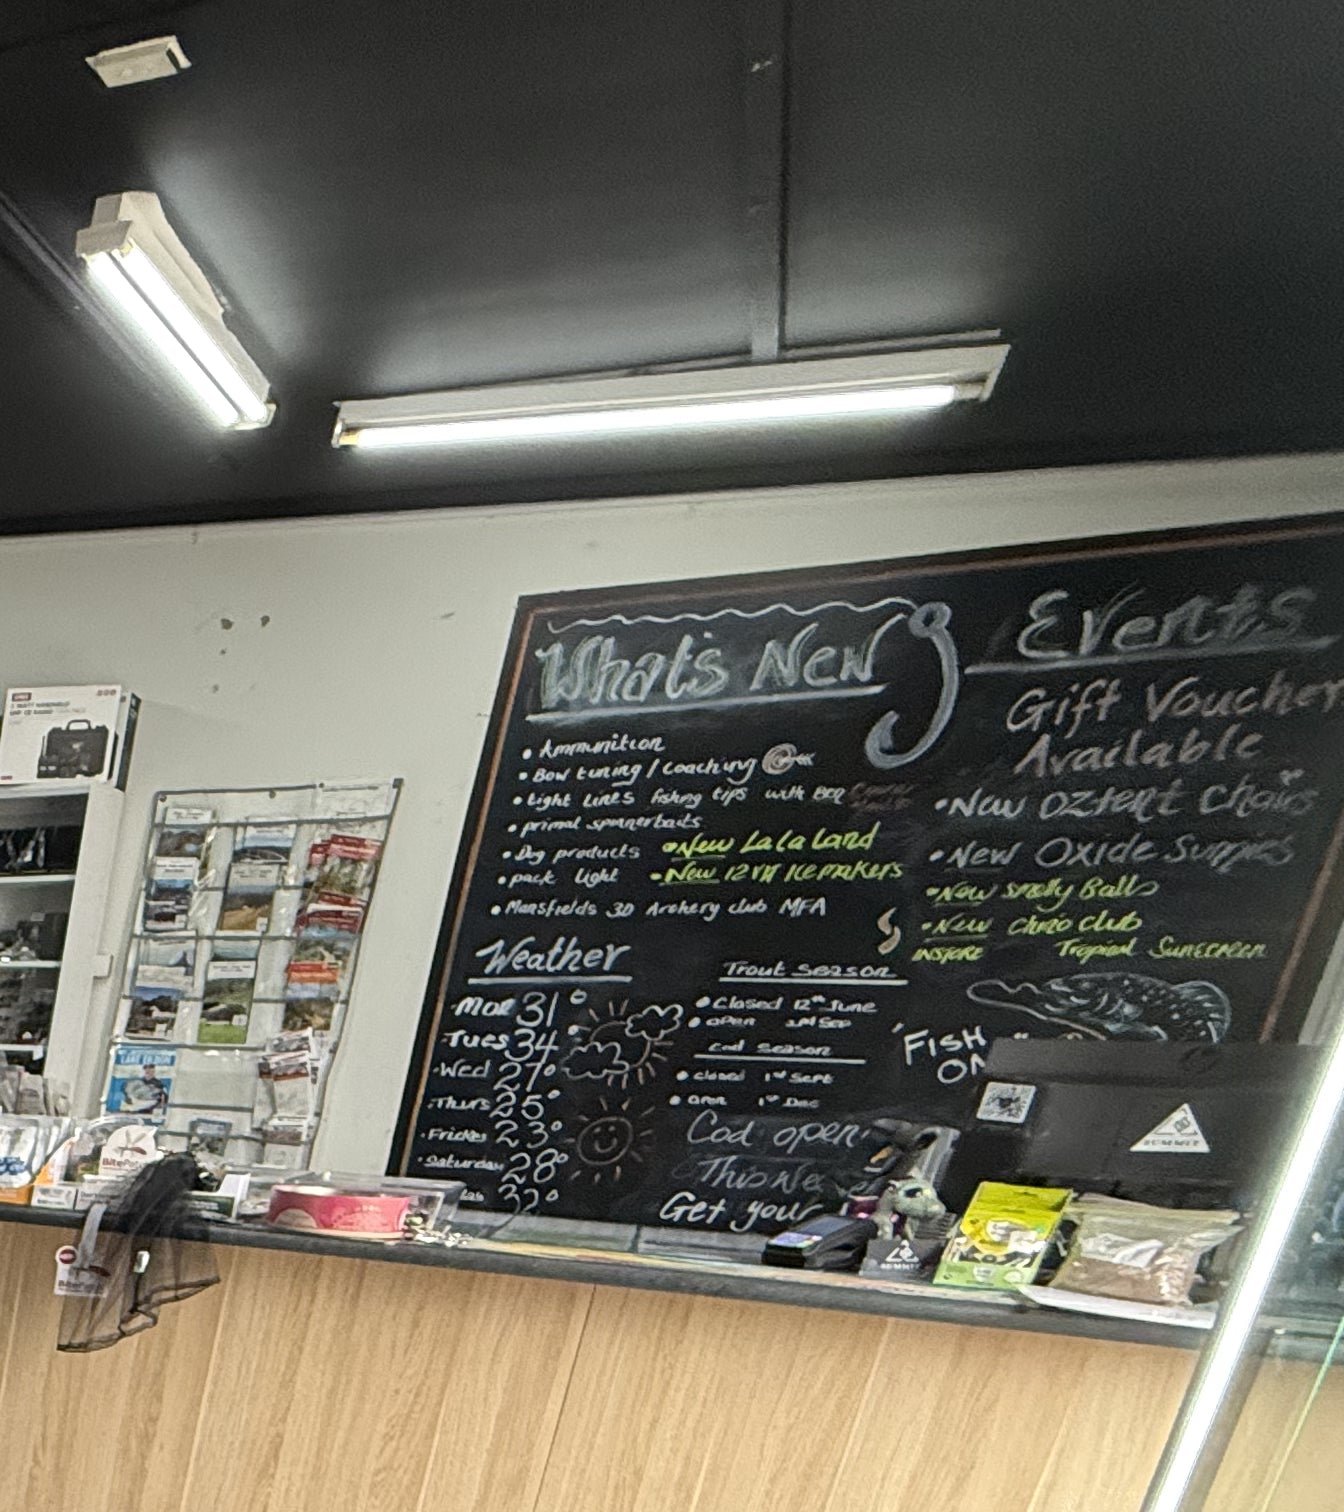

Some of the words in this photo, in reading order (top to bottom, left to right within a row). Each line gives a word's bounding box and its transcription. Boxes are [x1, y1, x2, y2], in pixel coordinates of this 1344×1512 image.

[535, 632, 729, 710] What's
[1007, 677, 1121, 739] Gift
[539, 734, 666, 759] Ammunition
[1014, 722, 1264, 779] Available
[552, 843, 641, 865] products
[1035, 833, 1158, 868] Oxide
[645, 900, 721, 922] Archery
[778, 897, 827, 917] MFA
[475, 936, 632, 974] Weather
[687, 1109, 755, 1148] Cod
[659, 1191, 727, 1225] Get
